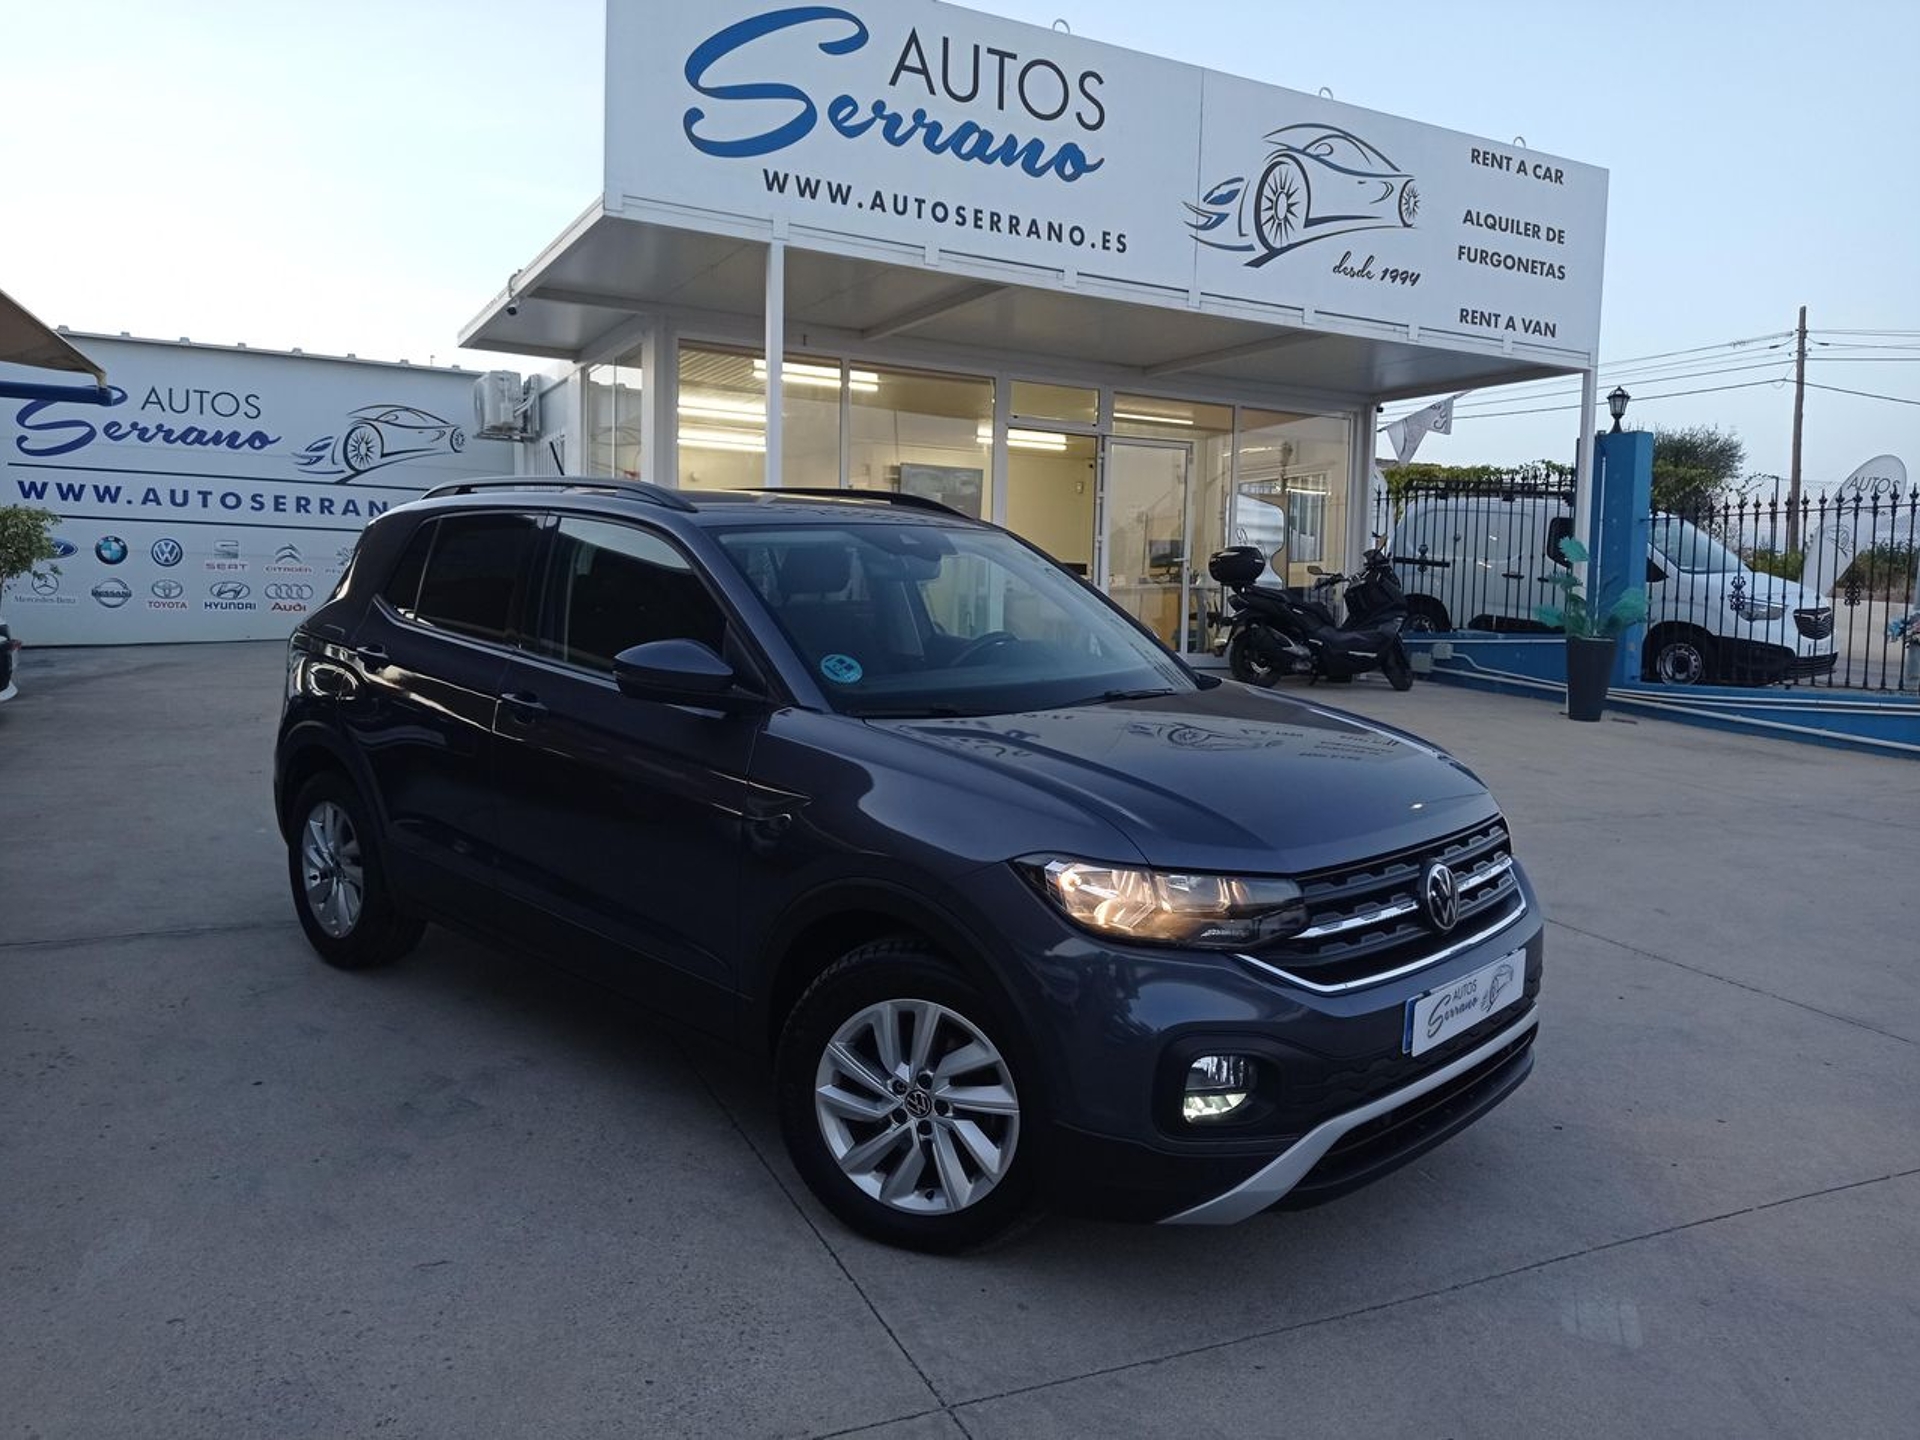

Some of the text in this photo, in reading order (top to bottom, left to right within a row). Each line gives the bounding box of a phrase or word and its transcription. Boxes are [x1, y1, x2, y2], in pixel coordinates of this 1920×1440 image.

[683, 6, 1105, 182] Serrano
[889, 27, 1106, 132] AUTOS
[1471, 148, 1564, 185] RENT A CAR
[763, 168, 1128, 254] WWW.AUTOSERRANO.ES
[1463, 209, 1565, 244] ALQUILER DE
[1332, 250, 1421, 286] desde 1994
[1457, 245, 1566, 280] FURGONETAS
[1459, 308, 1557, 338] RENT A VAN
[141, 386, 262, 420] AUTOS
[16, 385, 282, 457] Serrano
[148, 601, 187, 609] TOYOTA
[204, 602, 257, 610] HYUNDAI
[1453, 979, 1478, 1001] AUTOS
